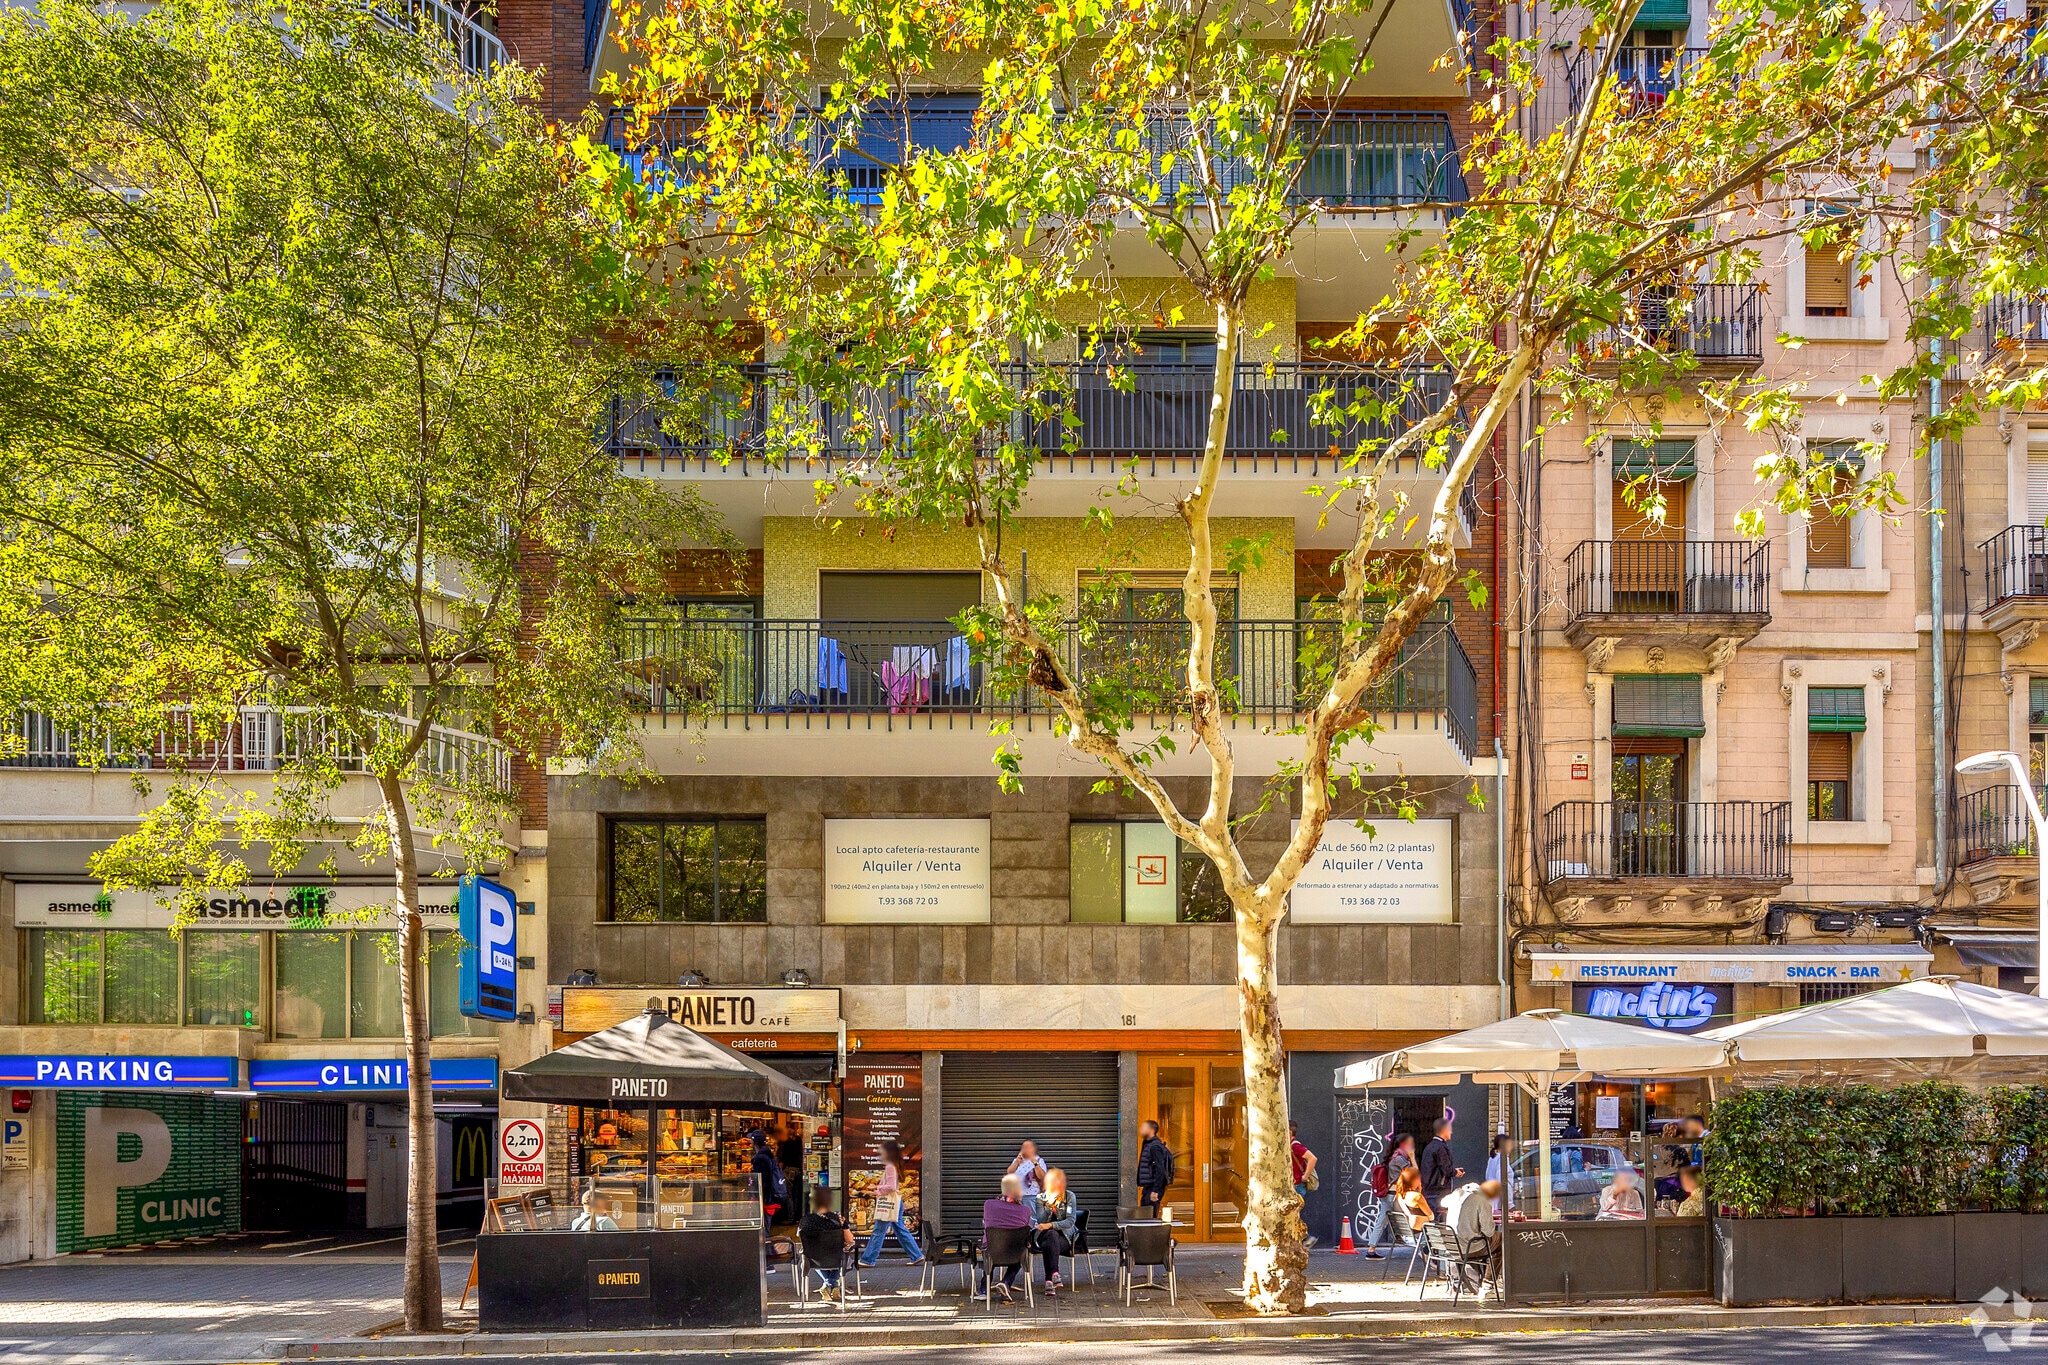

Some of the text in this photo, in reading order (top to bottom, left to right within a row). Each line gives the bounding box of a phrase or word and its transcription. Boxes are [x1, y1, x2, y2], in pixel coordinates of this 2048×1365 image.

[836, 846, 860, 854] Local
[862, 846, 883, 857] apto
[1316, 843, 1435, 854] CAL de 560 m2 (2 plantas)
[862, 860, 913, 874] Alquiler
[925, 860, 961, 872] Venta
[1322, 859, 1374, 873] Alquiler
[1386, 859, 1424, 870] Venta
[851, 883, 871, 891] (40m2
[881, 883, 900, 891] planta
[900, 883, 914, 891] baja
[1369, 882, 1399, 891] adaptado
[48, 900, 113, 913] asmedit
[878, 897, 939, 905] T.93 368 72 03
[1340, 897, 1400, 906] T.93 368 72 03
[480, 886, 514, 975] P
[1580, 966, 1678, 977] RESTAURANT
[1786, 966, 1837, 977] SNACK
[1850, 966, 1880, 977] BAR
[667, 996, 790, 1026] PANETO CAFÈ
[1121, 1014, 1136, 1026] 181
[731, 1038, 778, 1048] cafeteria
[36, 1061, 173, 1082] PARKING
[321, 1065, 410, 1085] CLINI
[611, 1078, 668, 1097] PANETO
[864, 1074, 905, 1089] PANETO
[866, 1094, 903, 1105] Catering
[696, 1122, 715, 1130] WIFI
[5, 1121, 22, 1144] P
[507, 1135, 539, 1148] 2,2m
[83, 1106, 173, 1238] P
[503, 1164, 542, 1174] ALÇADA
[502, 1173, 543, 1184] MÀXIMA
[141, 1196, 221, 1223] CLINIC
[660, 1205, 685, 1214] PANETO
[606, 1272, 641, 1285] PANETO
